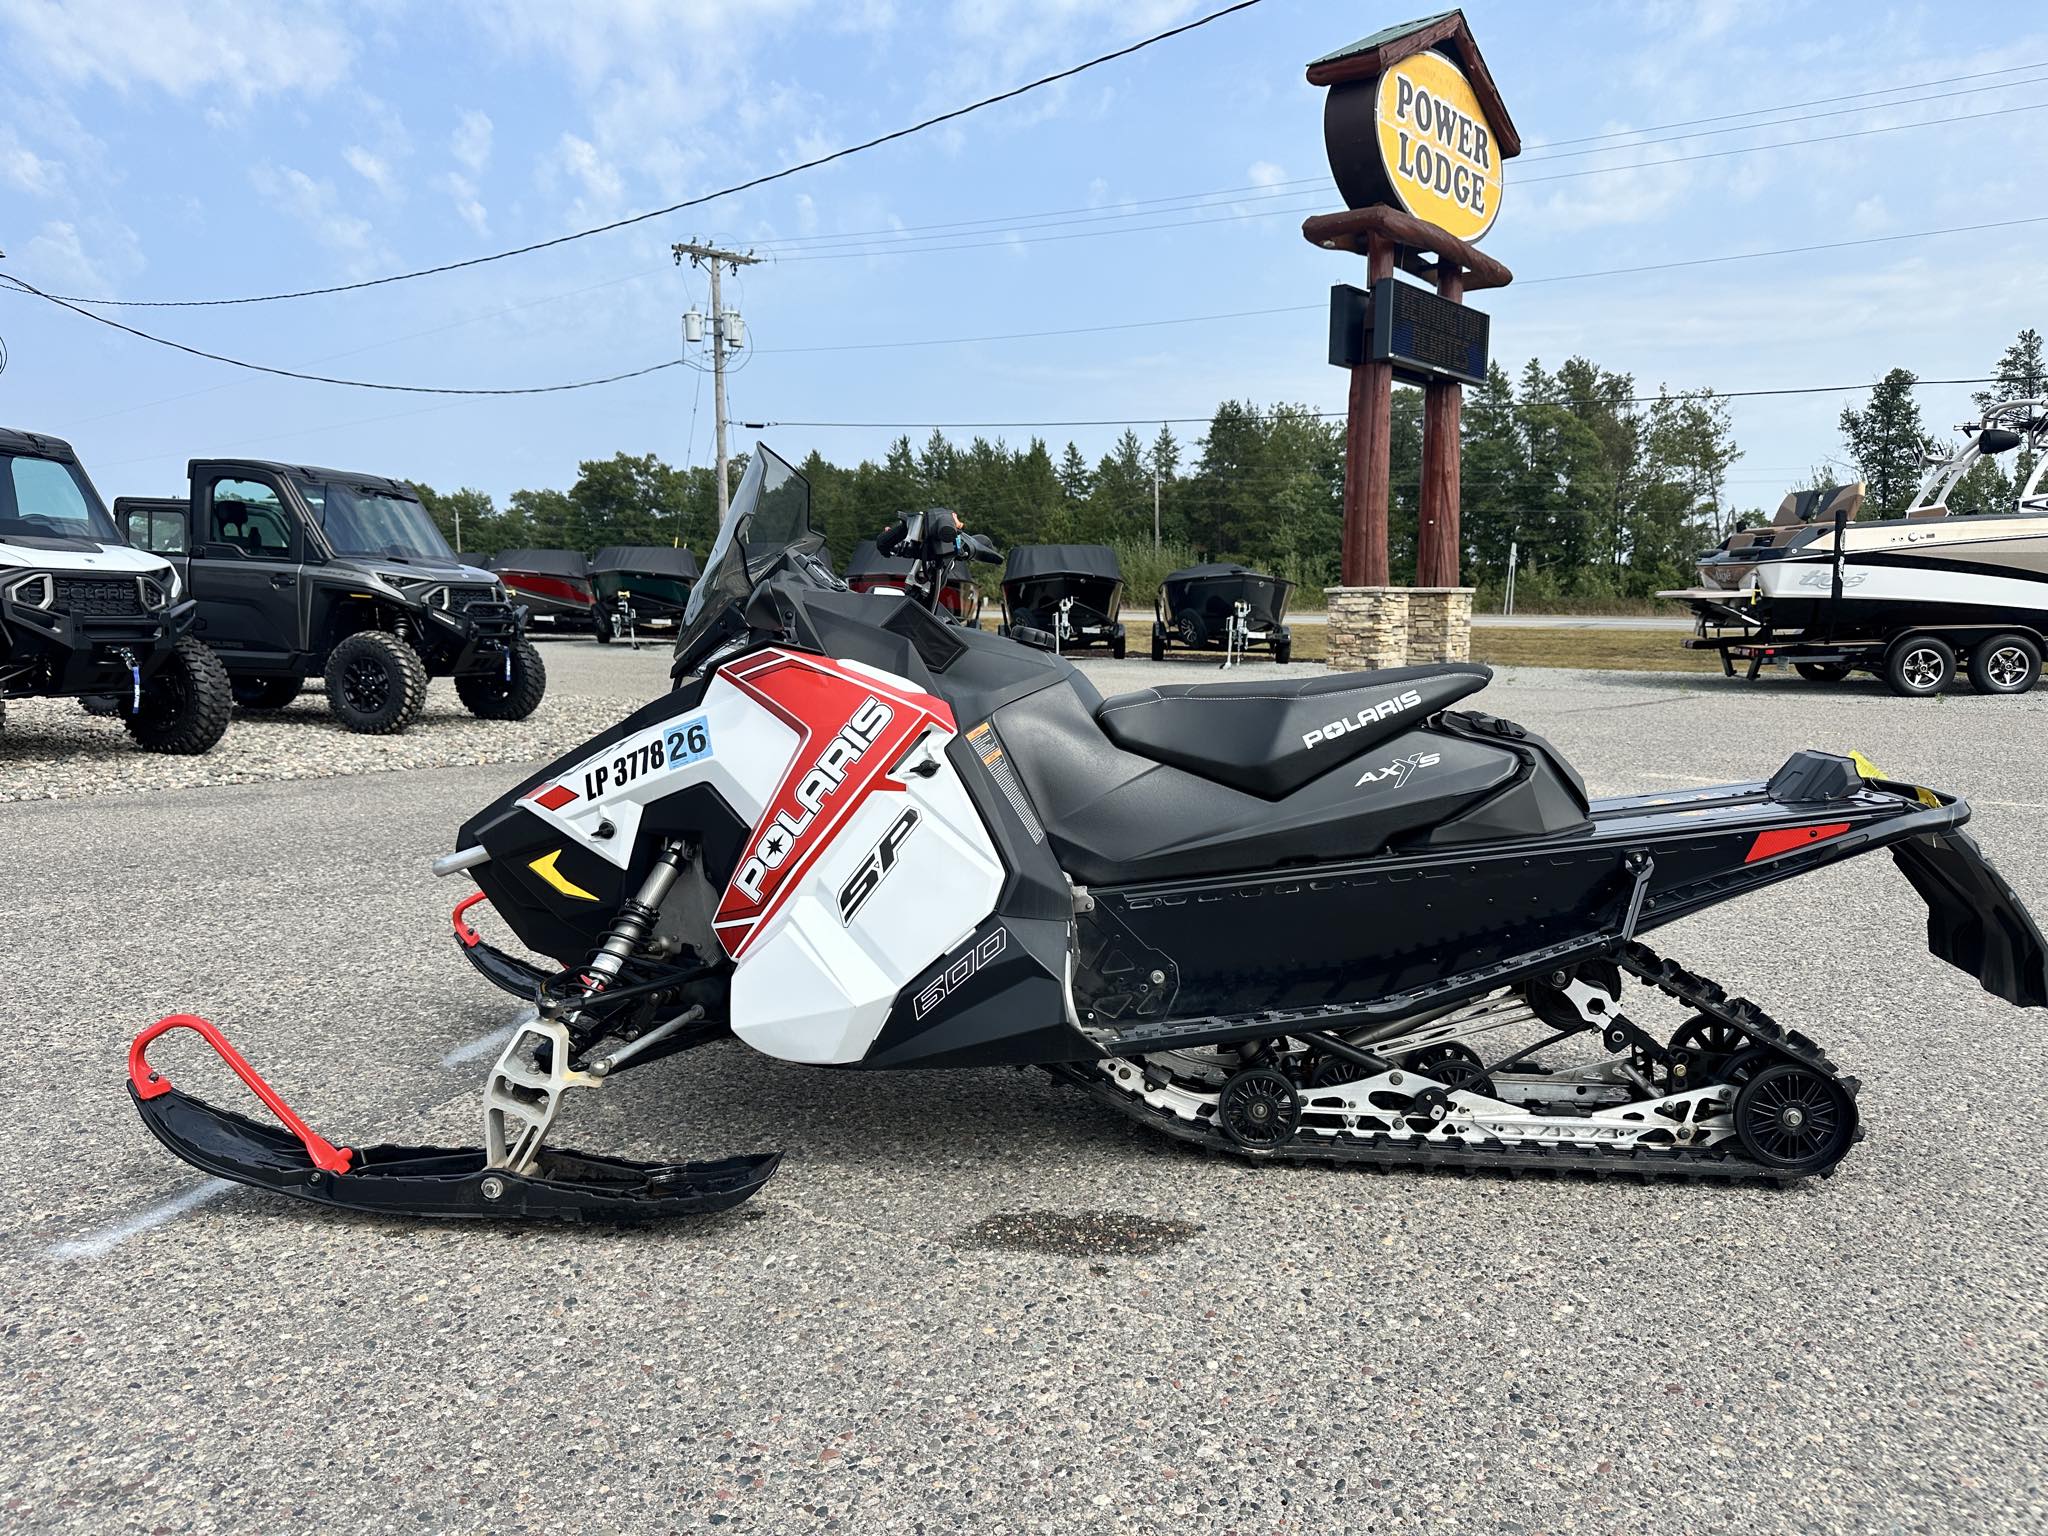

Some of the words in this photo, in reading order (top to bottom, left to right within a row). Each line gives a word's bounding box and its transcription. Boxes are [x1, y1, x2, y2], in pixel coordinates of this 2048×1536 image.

[1397, 76, 1489, 169] POWER
[1398, 132, 1485, 215] LODGE
[56, 586, 136, 600] POLARIS
[667, 724, 707, 763] 26
[1302, 689, 1422, 750] POLARIS
[585, 766, 608, 801] LP
[613, 739, 665, 787] 3778
[734, 695, 894, 904] POLARIS
[1354, 752, 1441, 789] AXYS
[837, 805, 923, 928] SP
[913, 926, 1007, 1021] 600
